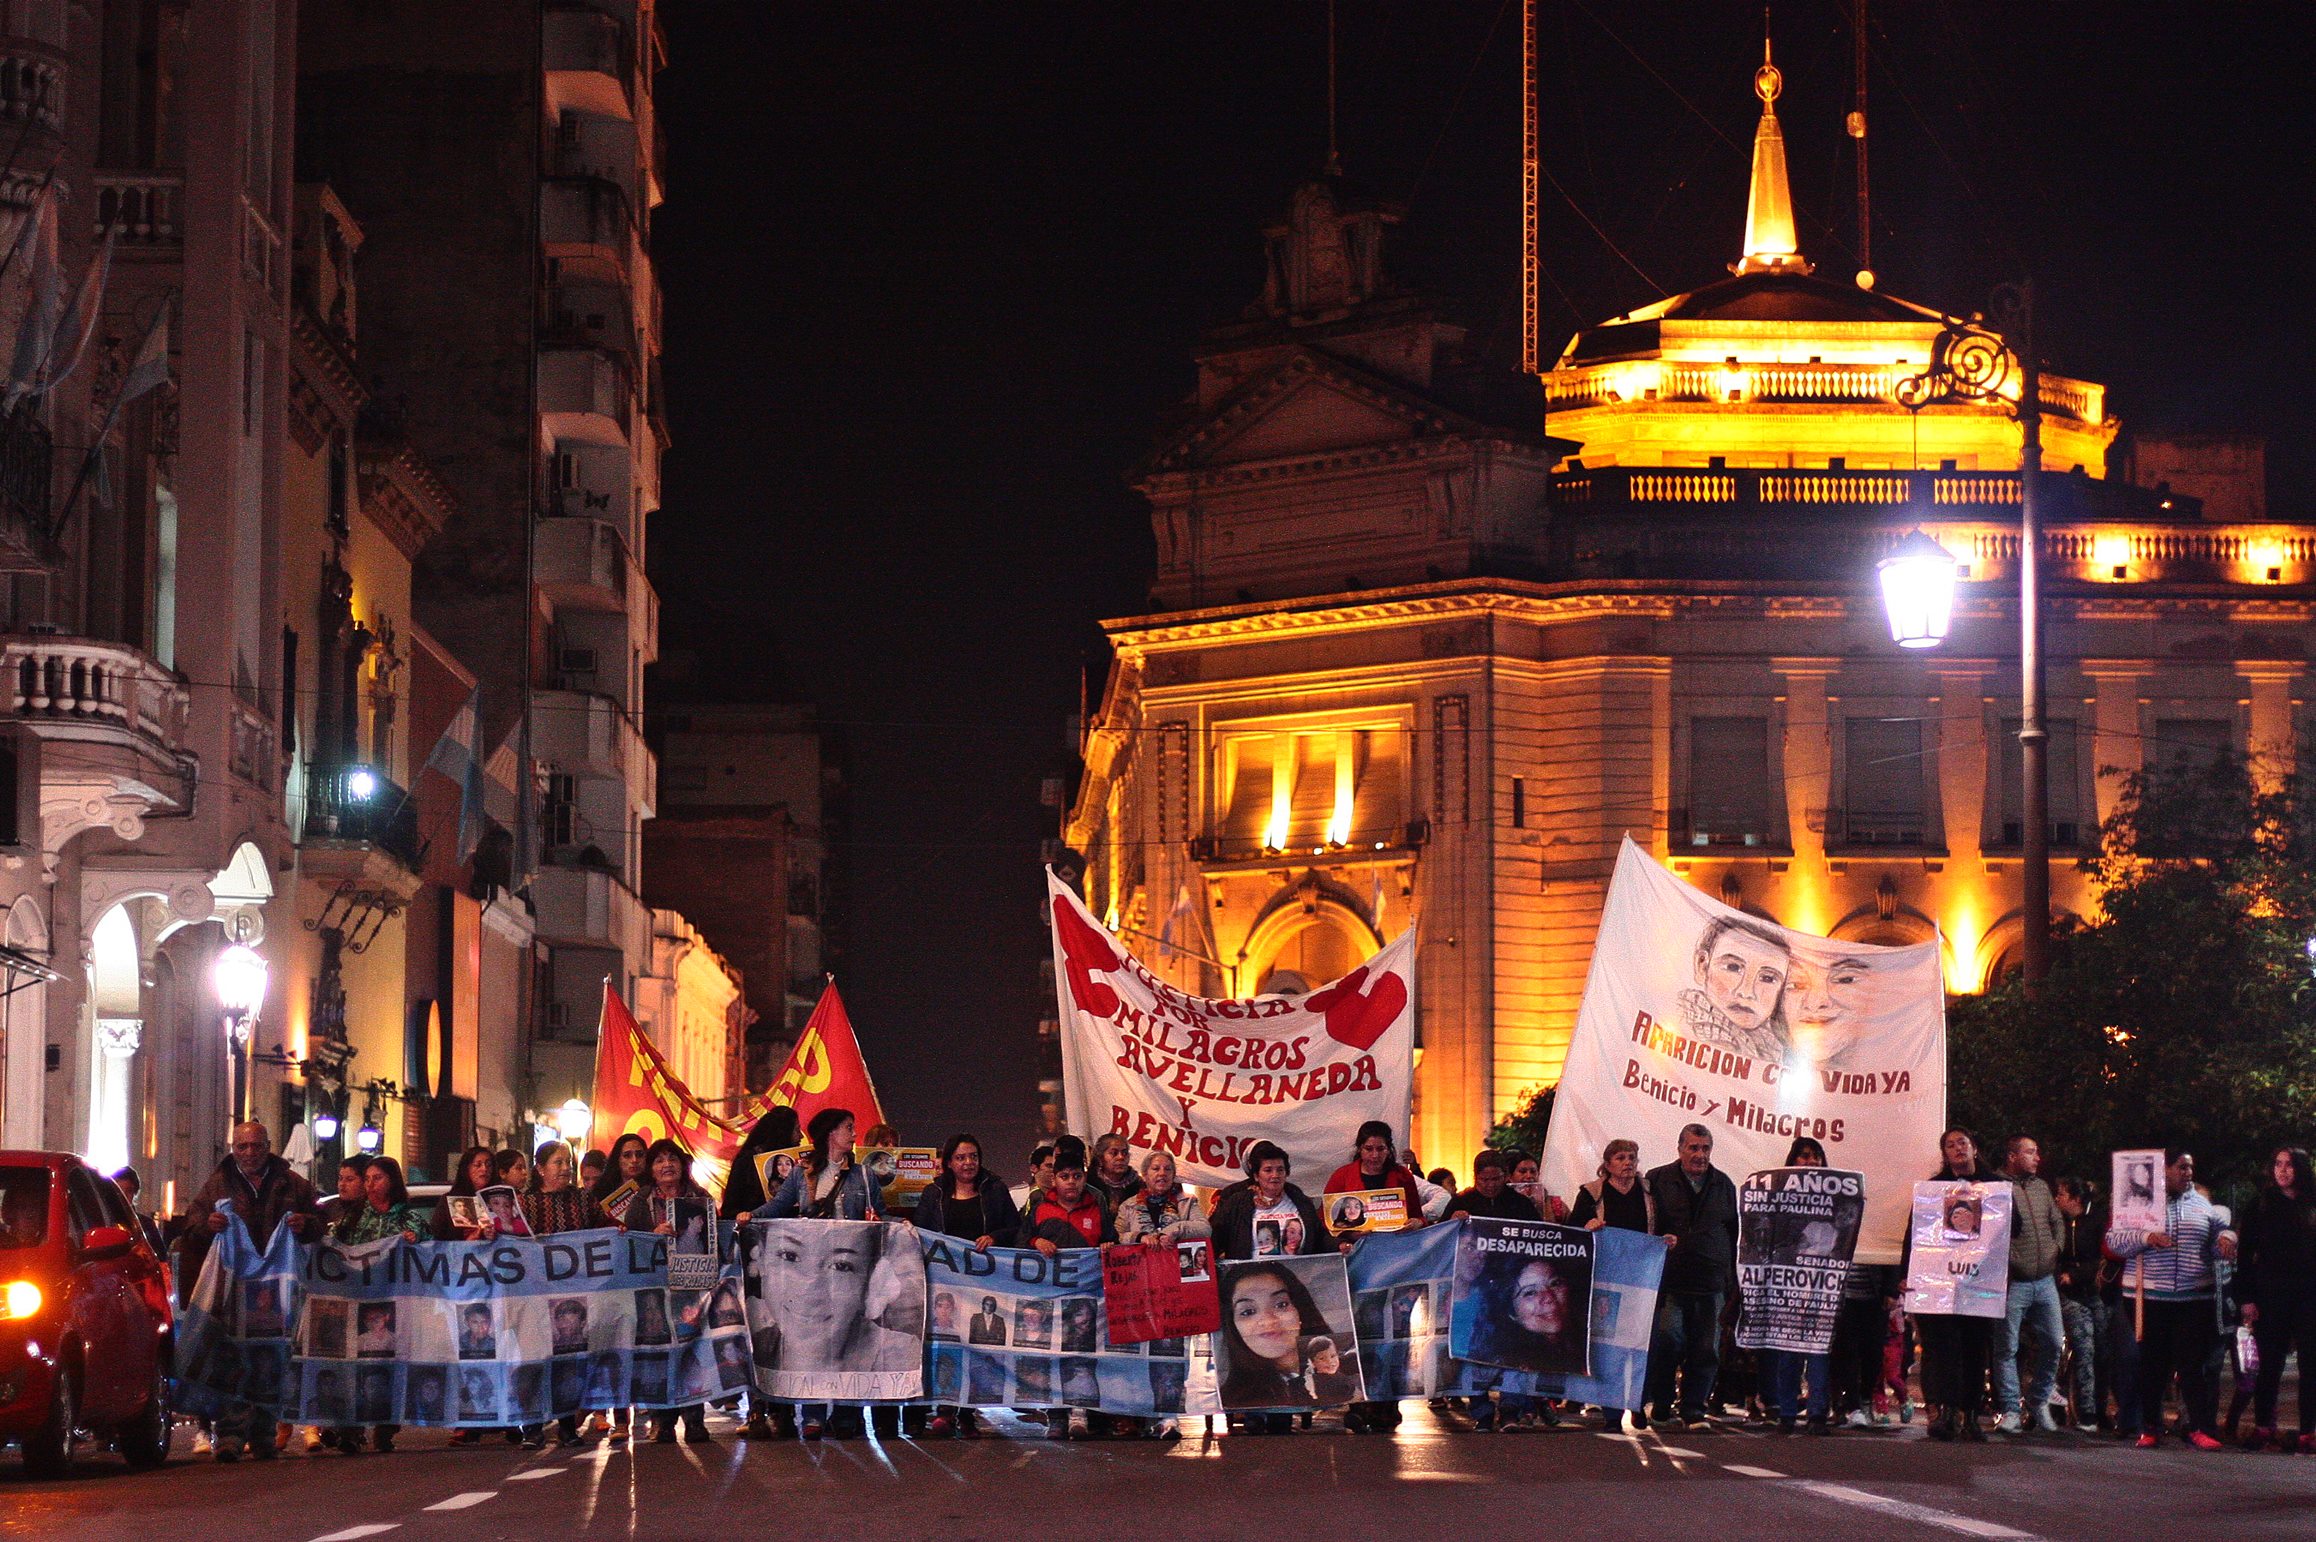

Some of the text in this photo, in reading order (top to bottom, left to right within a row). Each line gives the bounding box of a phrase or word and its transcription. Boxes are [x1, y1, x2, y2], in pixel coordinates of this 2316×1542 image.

[1113, 999, 1310, 1070] MILAGROS
[1631, 1009, 1753, 1081] APARICION
[1116, 1034, 1383, 1105] AVELLANEDA
[1622, 1058, 1697, 1111] Benicio
[1820, 1070, 1911, 1095] VIDA YA
[1176, 1096, 1198, 1130] Y
[898, 1160, 934, 1169] BUSCANDO
[1744, 1171, 1859, 1196] 11 AÑOS
[1367, 1200, 1403, 1211] BUSCANDO
[1743, 1203, 1834, 1217] PARA PAULINA
[1744, 1190, 1834, 1207] SIN JUSTICIA
[1502, 1226, 1562, 1240] SE BUSCA
[1476, 1237, 1587, 1258] DESAPARECIDA
[306, 1246, 526, 1287] ICTIMAS
[542, 1238, 614, 1281] DE
[1013, 1251, 1081, 1288] DE
[1947, 1261, 1980, 1277] LUIS
[838, 1372, 883, 1398] VIDA
